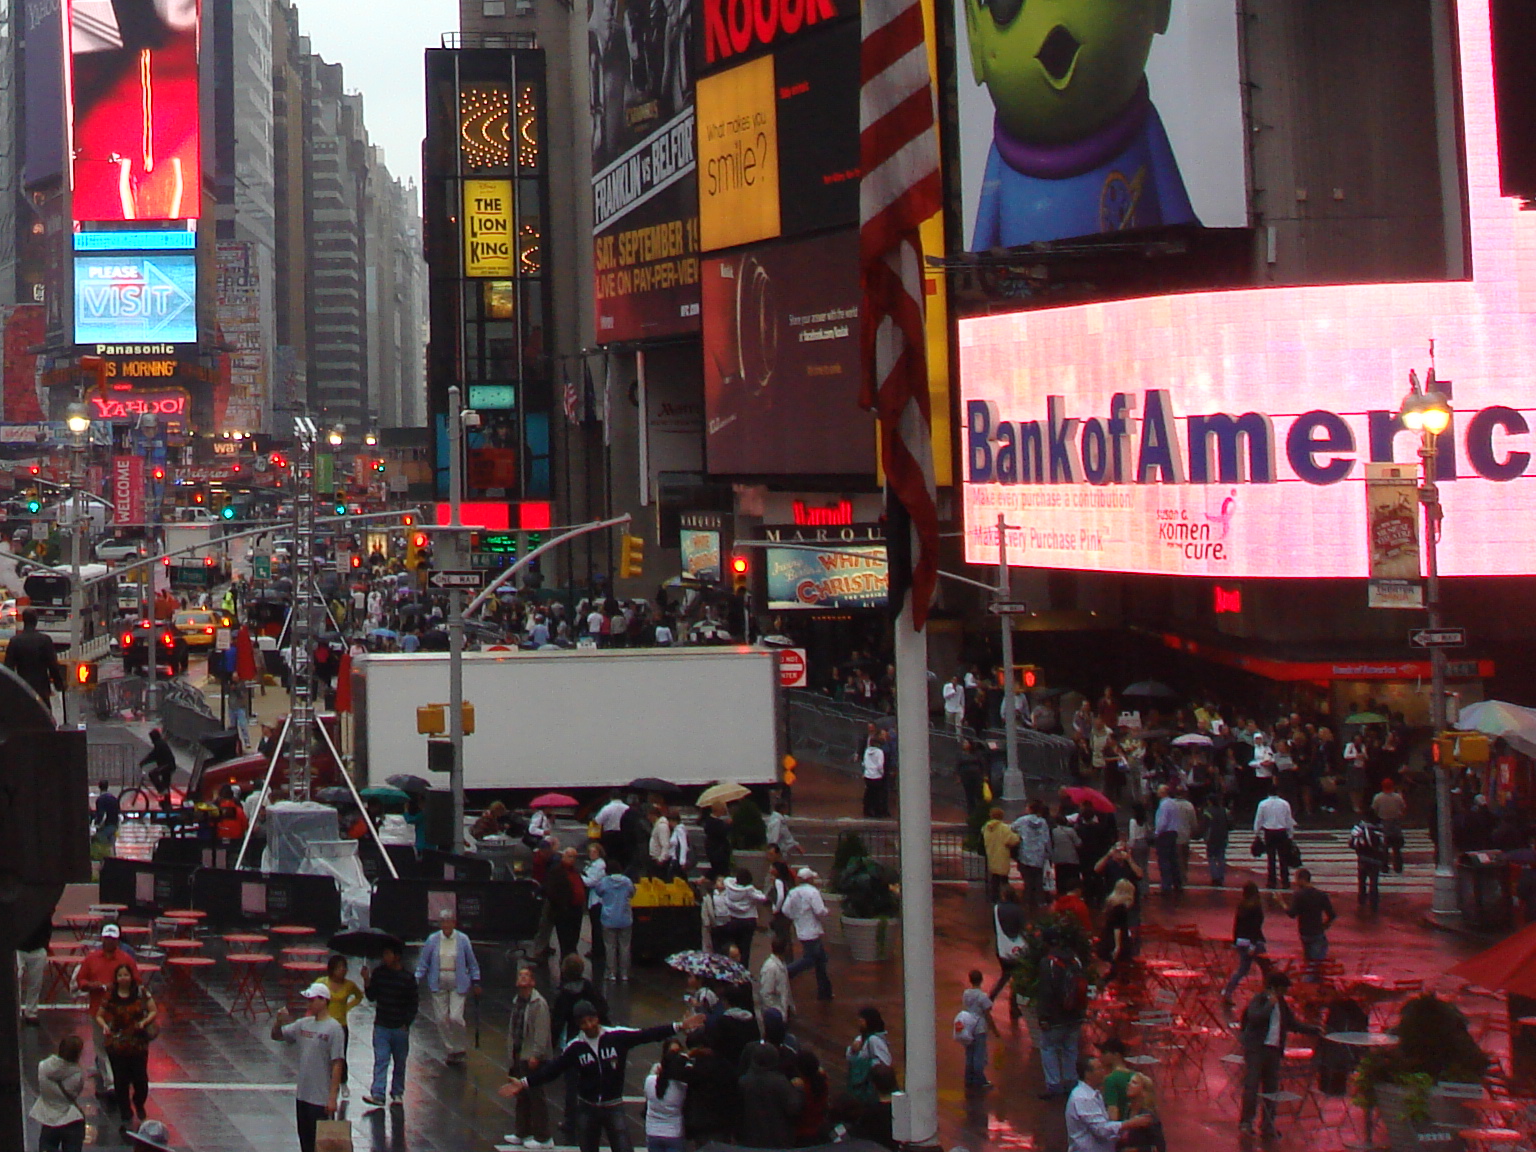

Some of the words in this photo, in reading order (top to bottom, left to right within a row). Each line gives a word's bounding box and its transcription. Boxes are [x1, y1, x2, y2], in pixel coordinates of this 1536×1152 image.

[707, 121, 725, 142] What
[726, 115, 751, 136] makes
[708, 132, 767, 197] smile?
[595, 155, 641, 224] FRANKLIN
[475, 198, 502, 211] THE
[471, 216, 507, 238] LION
[471, 240, 509, 264] KING
[596, 236, 617, 271] SAT.
[619, 219, 684, 266] SEPTEMBER
[89, 266, 138, 278] PLEASE
[596, 272, 615, 298] LIVE
[618, 270, 632, 295] ON
[85, 286, 173, 317] VISIT
[96, 344, 175, 355] Panasonic
[117, 460, 130, 524] WELCOME
[973, 489, 995, 507] Make
[998, 492, 1020, 512] every
[1021, 490, 1062, 510] purchase
[1064, 494, 1070, 507] a
[1073, 491, 1134, 508] contribution.
[974, 525, 999, 546] Make
[1031, 528, 1077, 549] Purchase
[1185, 542, 1227, 560] cure.
